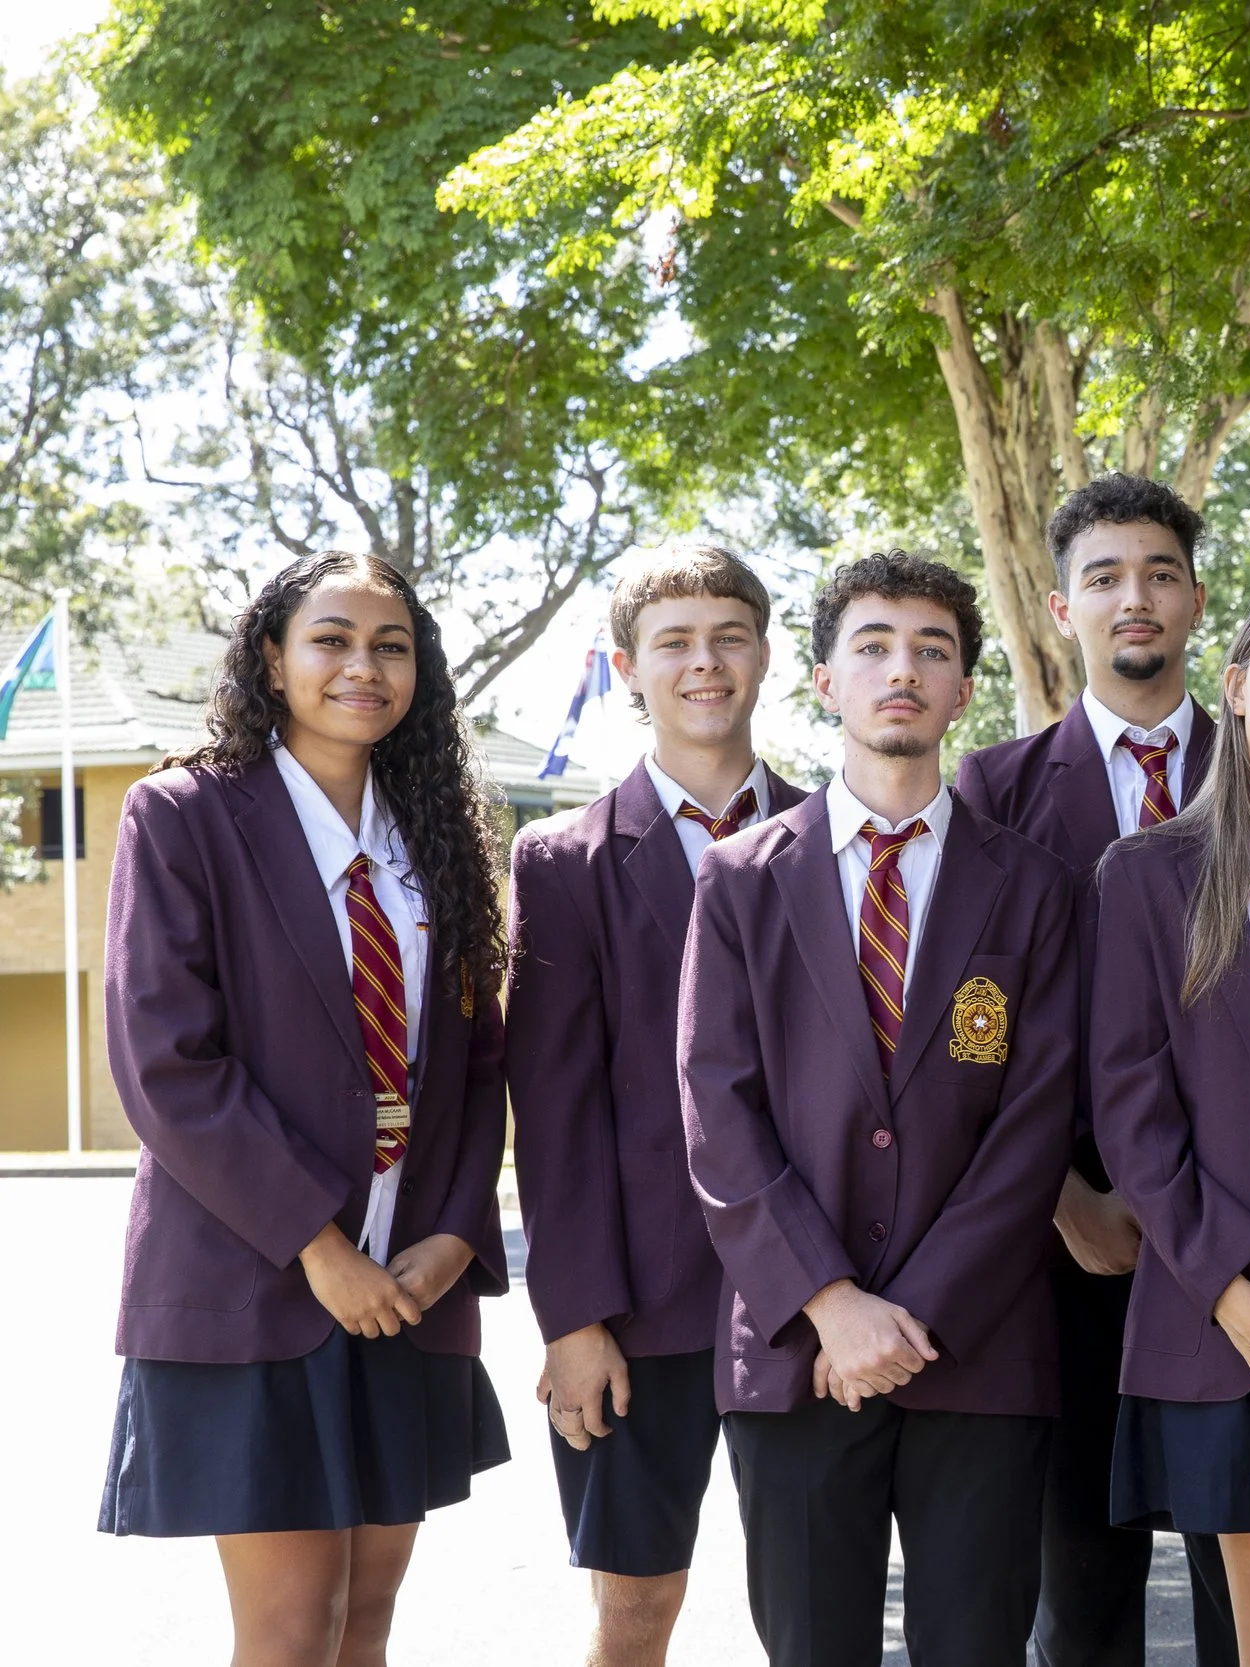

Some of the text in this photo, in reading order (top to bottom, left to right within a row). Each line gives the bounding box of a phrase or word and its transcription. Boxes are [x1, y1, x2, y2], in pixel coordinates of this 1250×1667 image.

[956, 982, 975, 1000] FAITHFUL
[988, 982, 1005, 1004] FOREVER
[955, 1008, 1006, 1051] CHRISTIAN BROTHERS COLLEGE
